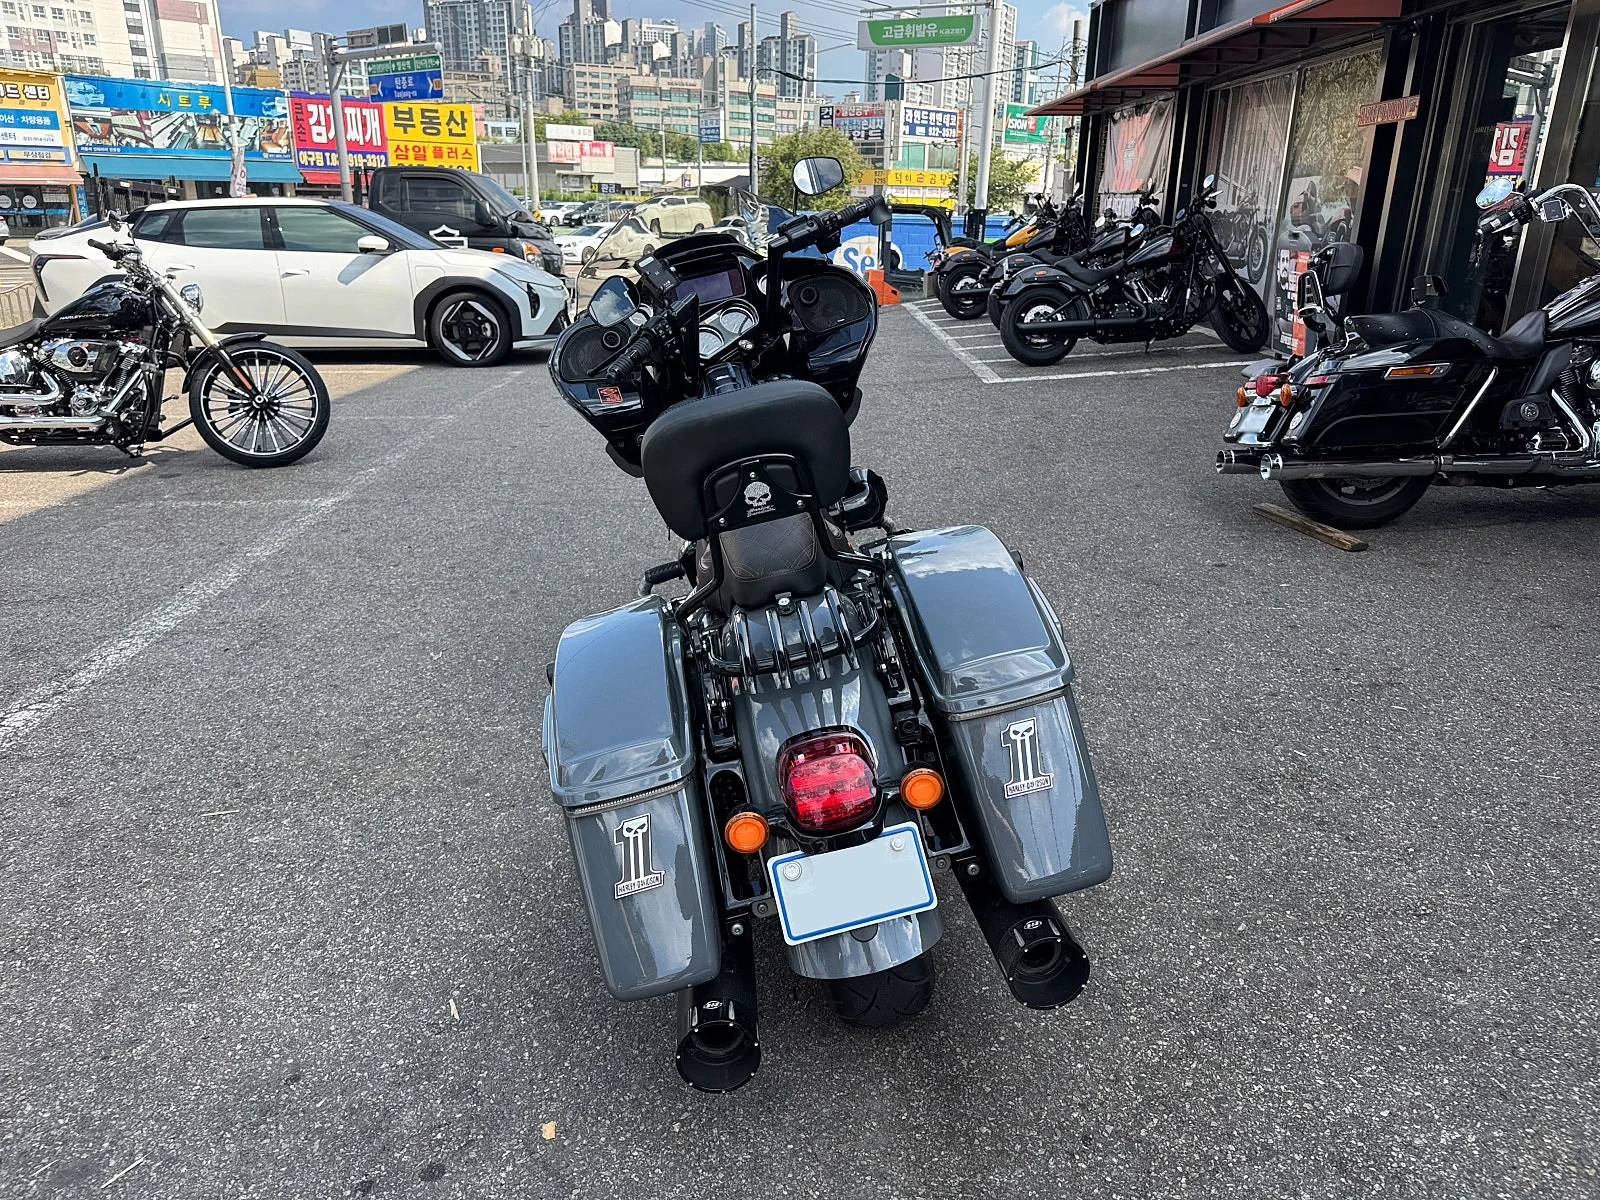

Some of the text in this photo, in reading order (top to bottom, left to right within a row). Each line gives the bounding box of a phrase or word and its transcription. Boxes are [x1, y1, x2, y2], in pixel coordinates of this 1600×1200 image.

[882, 23, 938, 39] 고급휘발유
[158, 93, 212, 108] 시트루
[392, 105, 468, 138] 부동산
[299, 150, 325, 167] 아구찜
[394, 144, 473, 161] 삼일 플러스
